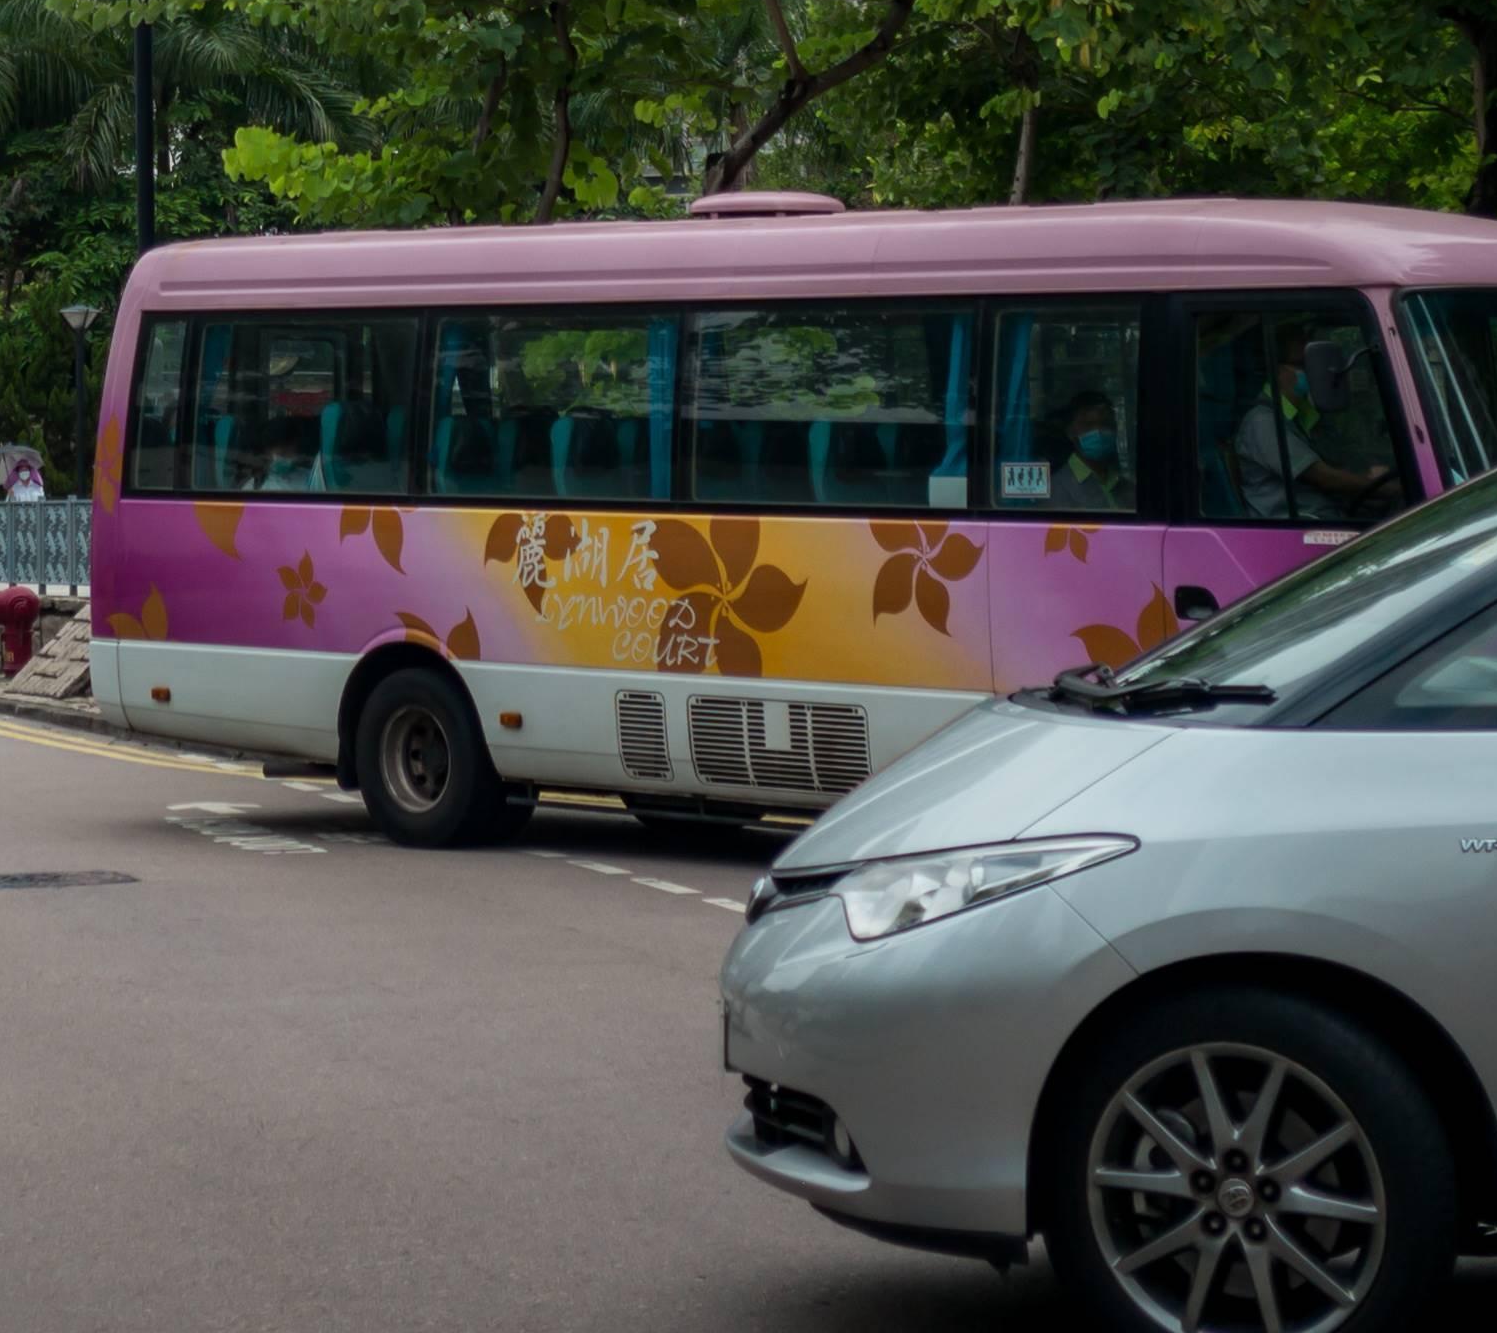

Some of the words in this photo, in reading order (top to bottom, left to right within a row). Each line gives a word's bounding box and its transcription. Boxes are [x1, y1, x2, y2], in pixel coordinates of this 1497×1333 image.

[512, 512, 659, 591] 麗湖居
[535, 593, 696, 630] LYNWOOD
[612, 631, 720, 666] COURT
